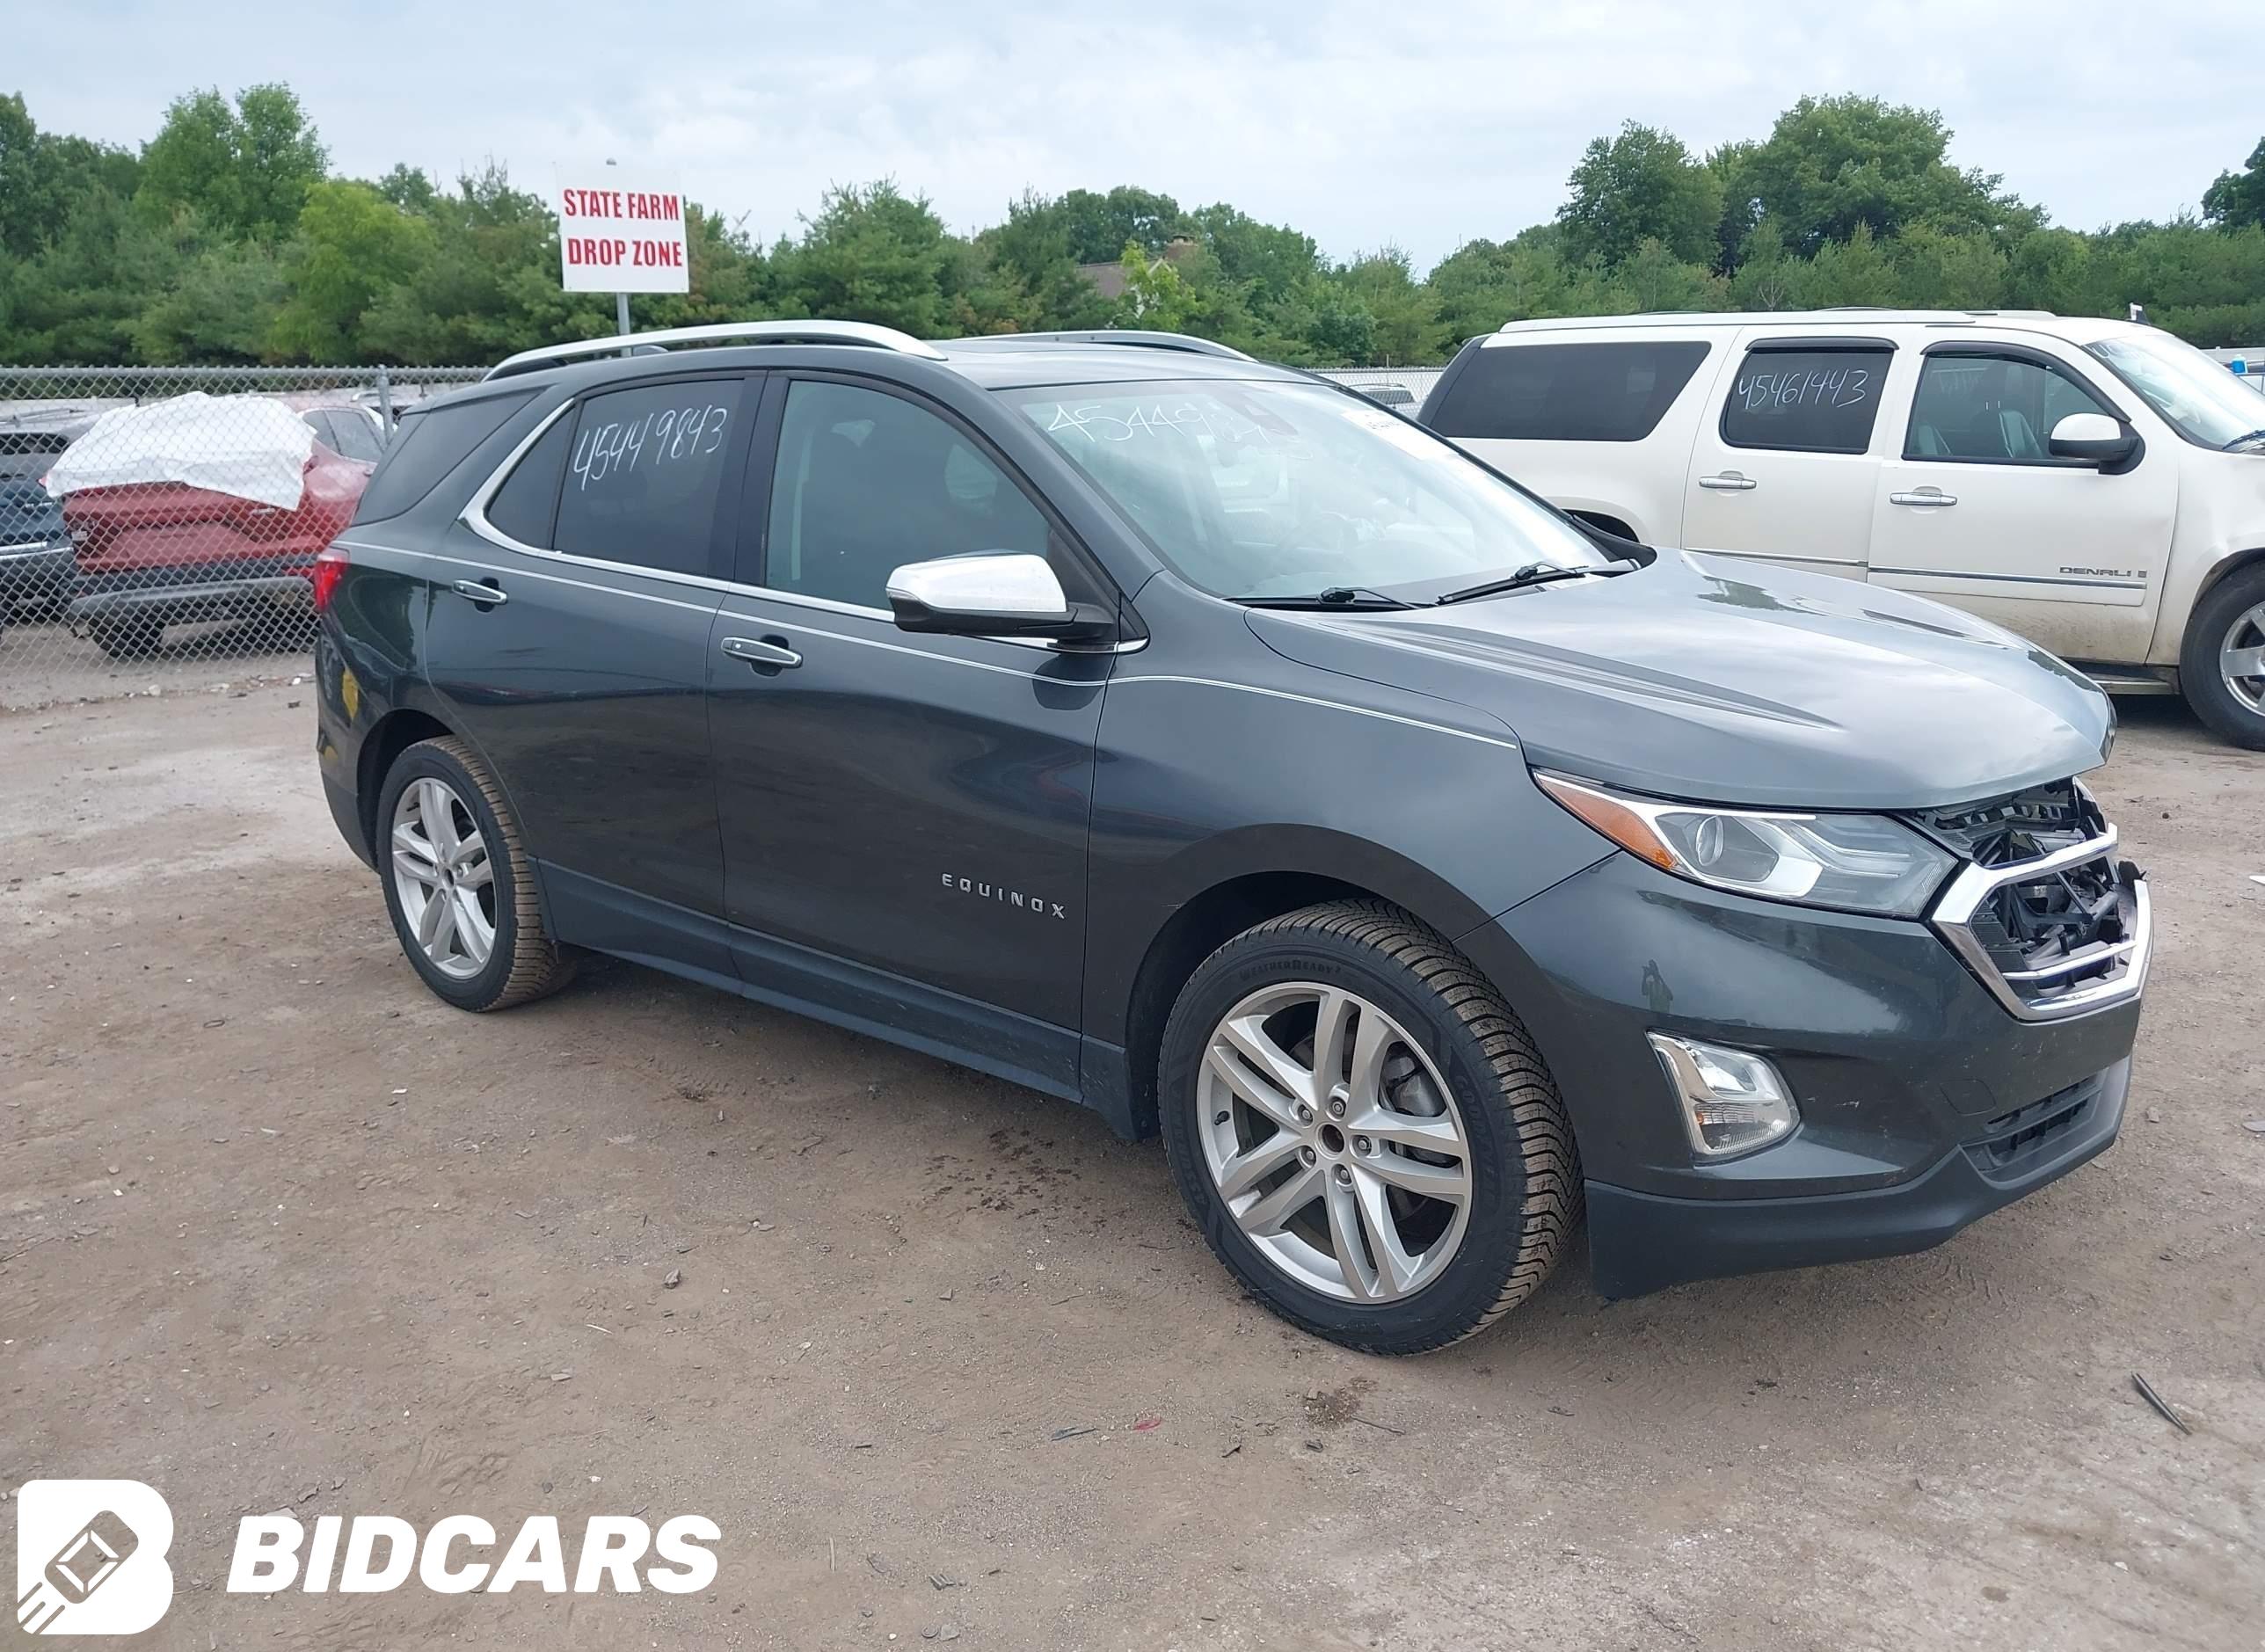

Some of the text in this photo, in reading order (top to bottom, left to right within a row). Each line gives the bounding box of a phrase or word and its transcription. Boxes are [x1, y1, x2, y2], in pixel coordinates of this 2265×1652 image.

[564, 189, 679, 220] STATE FARM
[568, 237, 682, 266] DROP ZONE
[1738, 368, 1868, 410] 45461443
[573, 404, 727, 491] 45449843
[2059, 566, 2131, 578] DENALI
[942, 873, 1065, 920] EQUINOX
